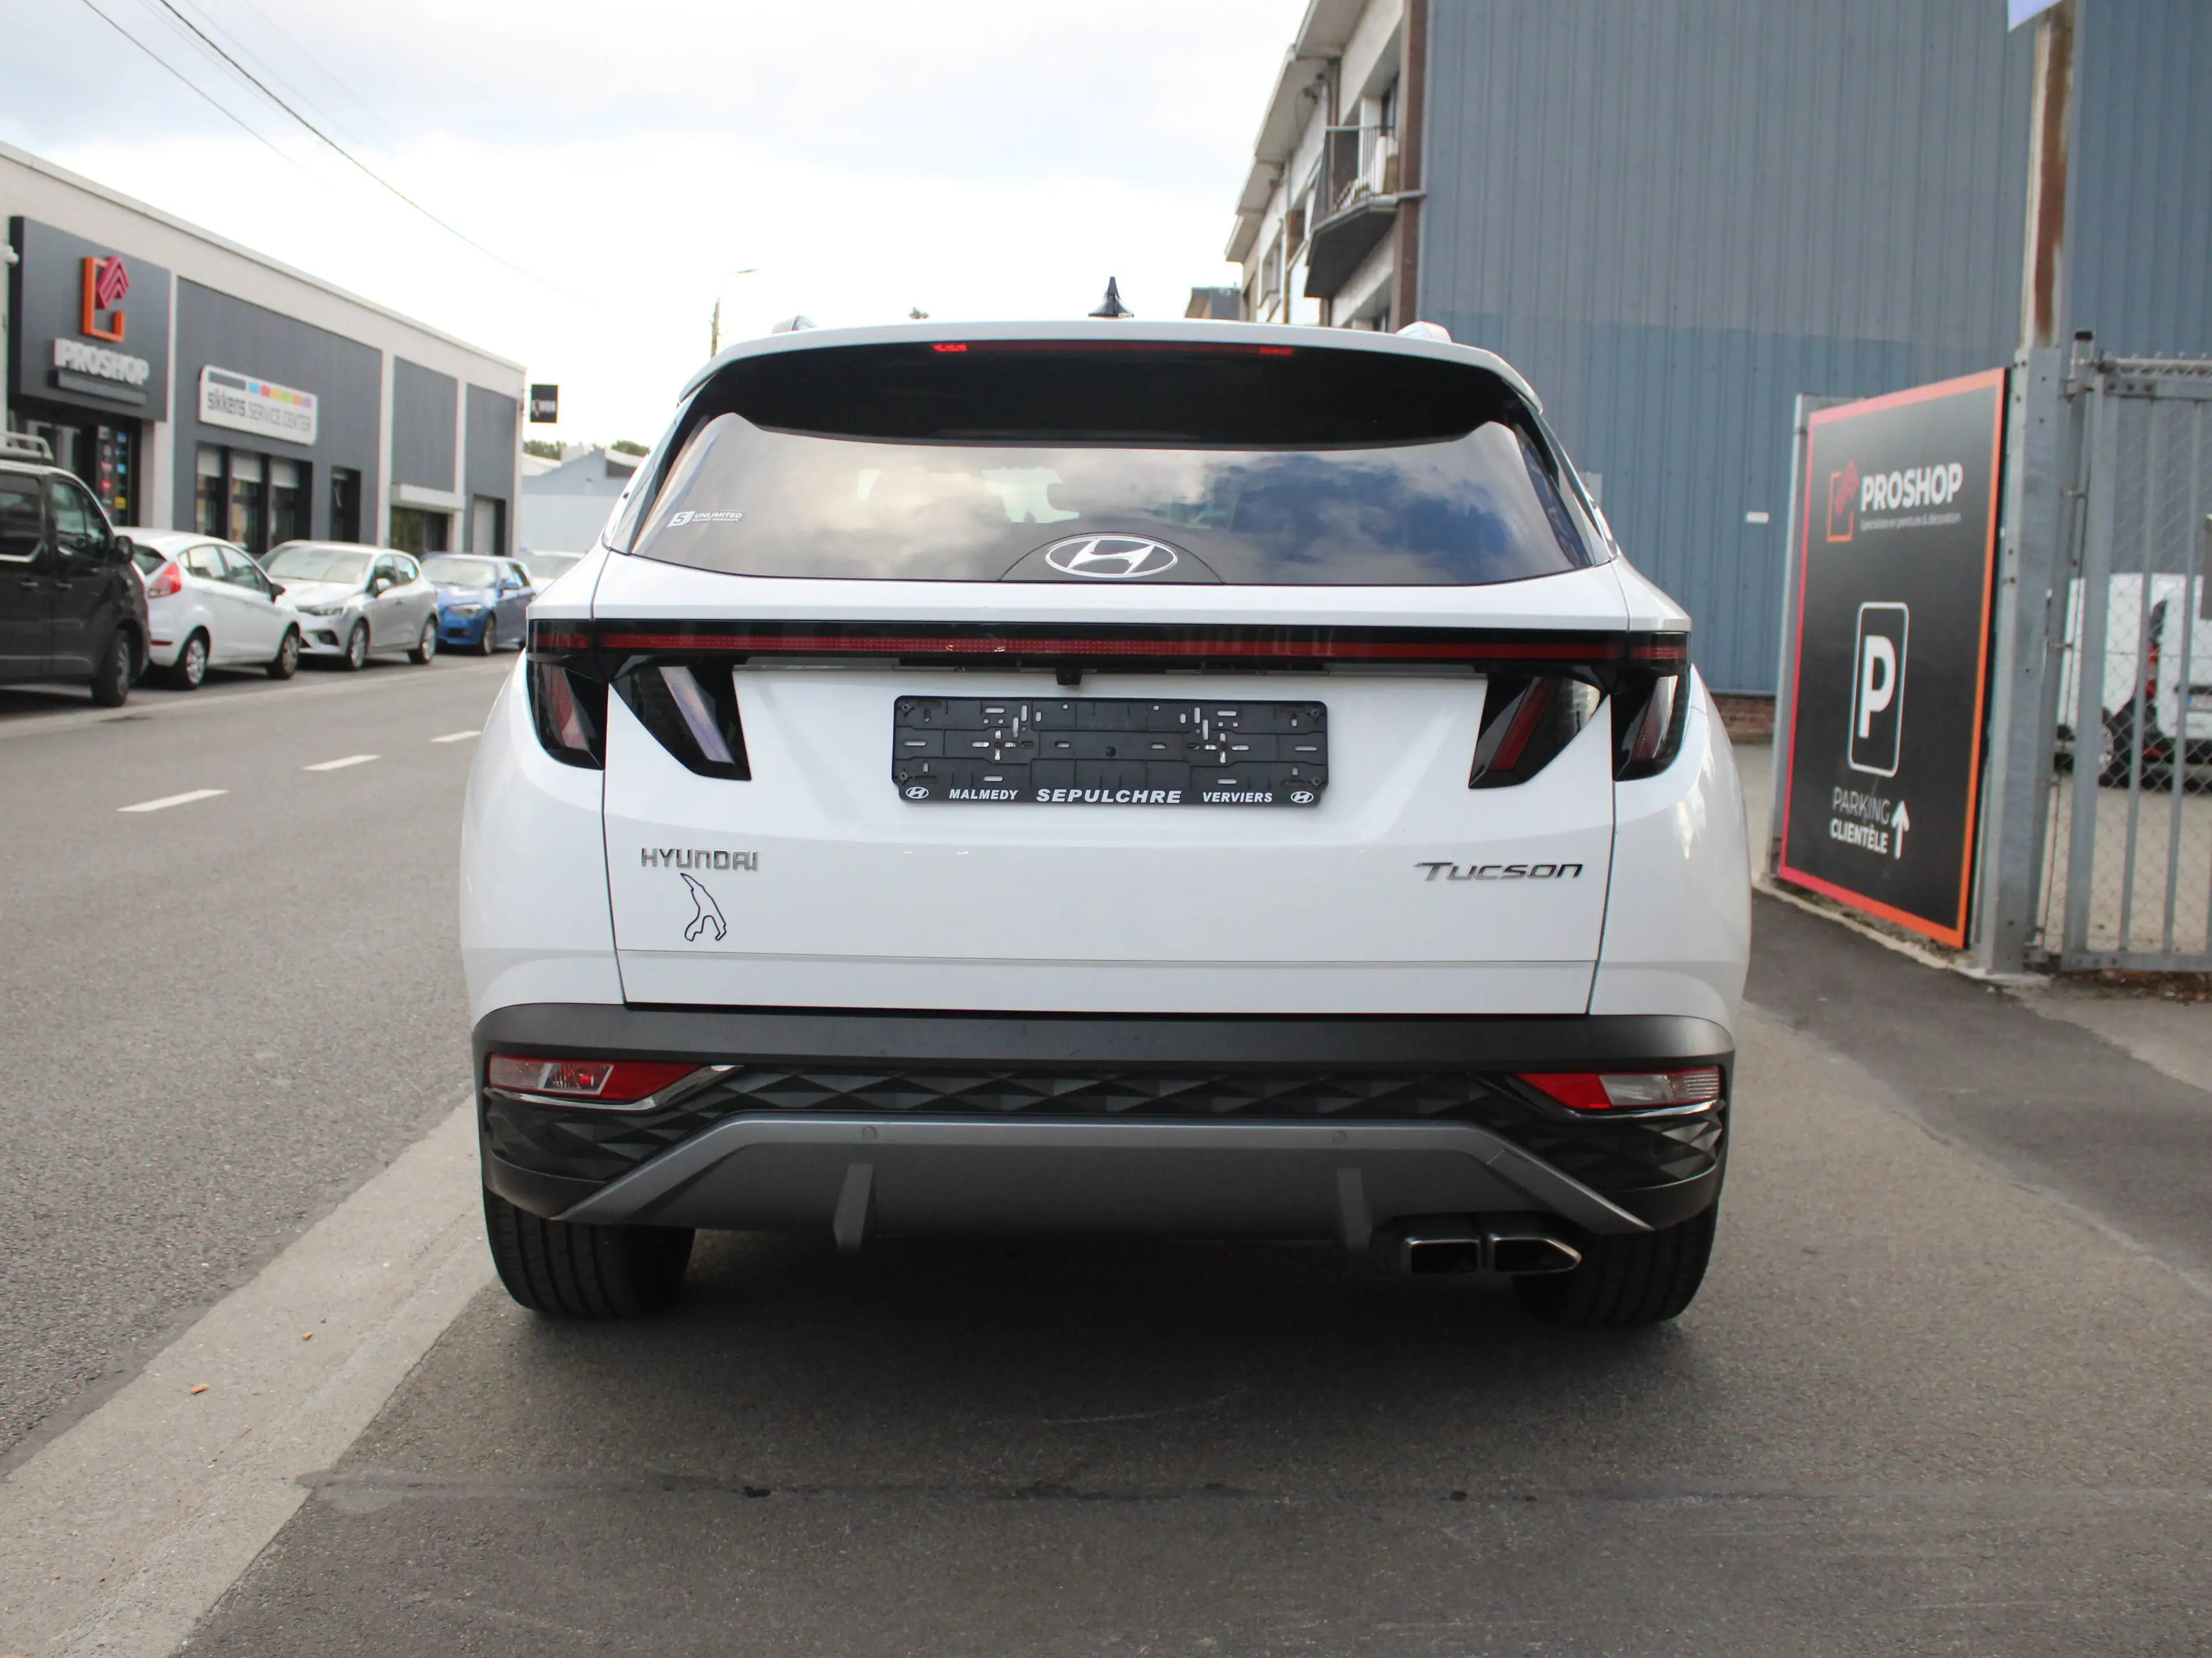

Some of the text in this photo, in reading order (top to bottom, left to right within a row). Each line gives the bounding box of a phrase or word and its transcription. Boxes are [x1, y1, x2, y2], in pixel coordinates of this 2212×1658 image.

[54, 337, 150, 386] PROSHOP
[207, 388, 246, 417] sikkens
[1860, 462, 1964, 512] PROSHOP
[1858, 635, 1896, 738] P
[949, 788, 1273, 803] MALMEDY SEPULCHRE VERVIERS
[1832, 786, 1891, 825] PARKING
[1830, 817, 1889, 848] CLIENTÈLE
[641, 847, 758, 871] HYUNDAI
